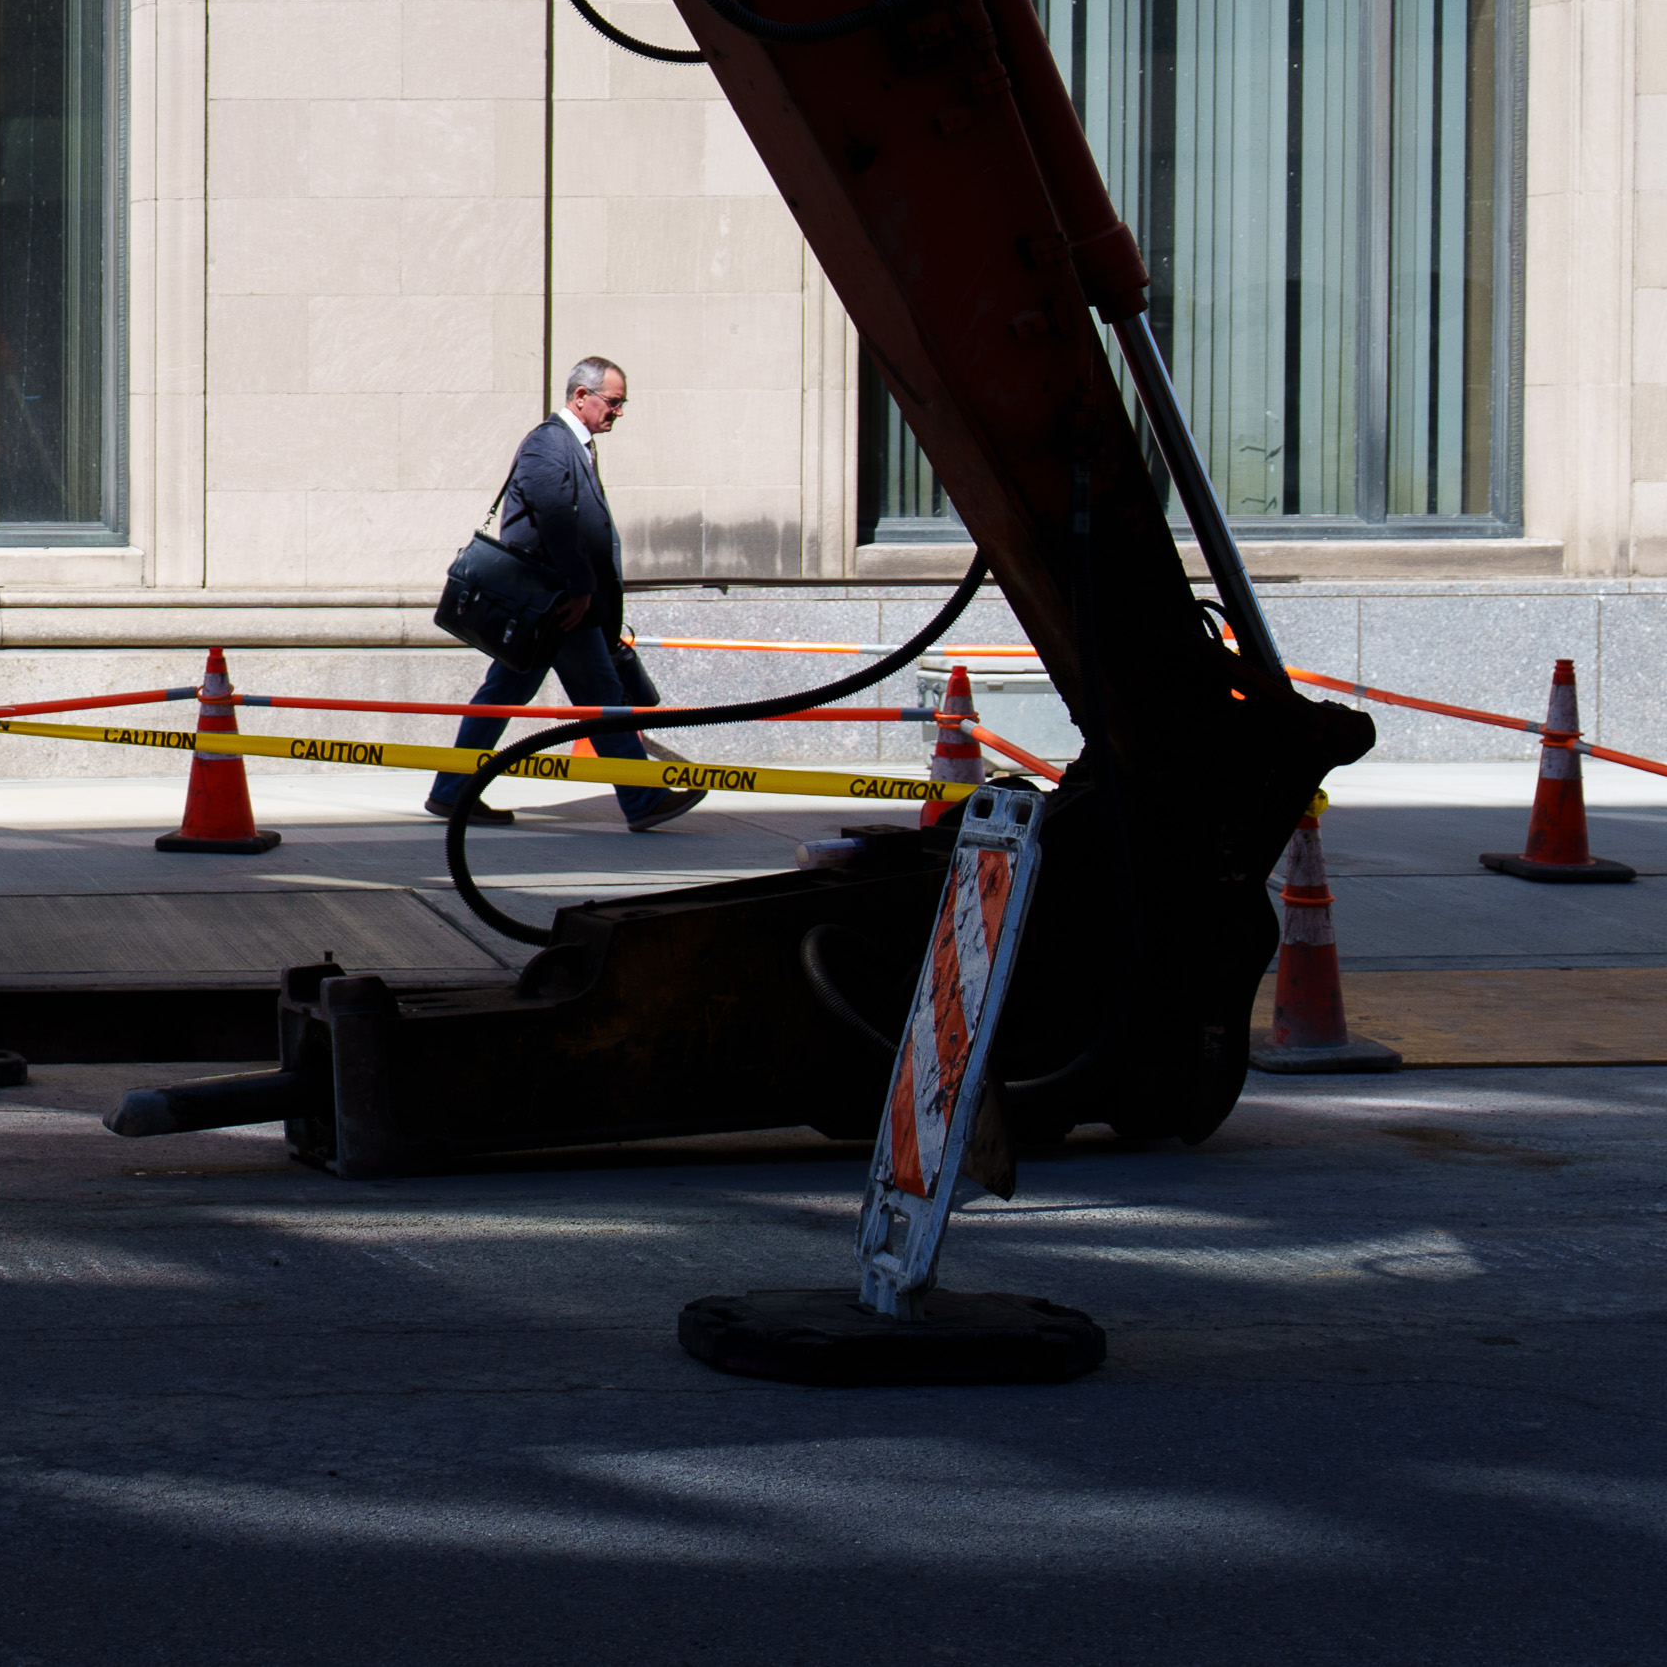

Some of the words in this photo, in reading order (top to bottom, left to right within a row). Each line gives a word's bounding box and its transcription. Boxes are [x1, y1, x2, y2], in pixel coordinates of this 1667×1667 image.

[104, 729, 197, 750] CAUTION
[290, 739, 383, 765] CAUTION
[476, 752, 570, 778] CUTION
[662, 766, 757, 790] CAUTION
[849, 778, 946, 800] CAUTION
